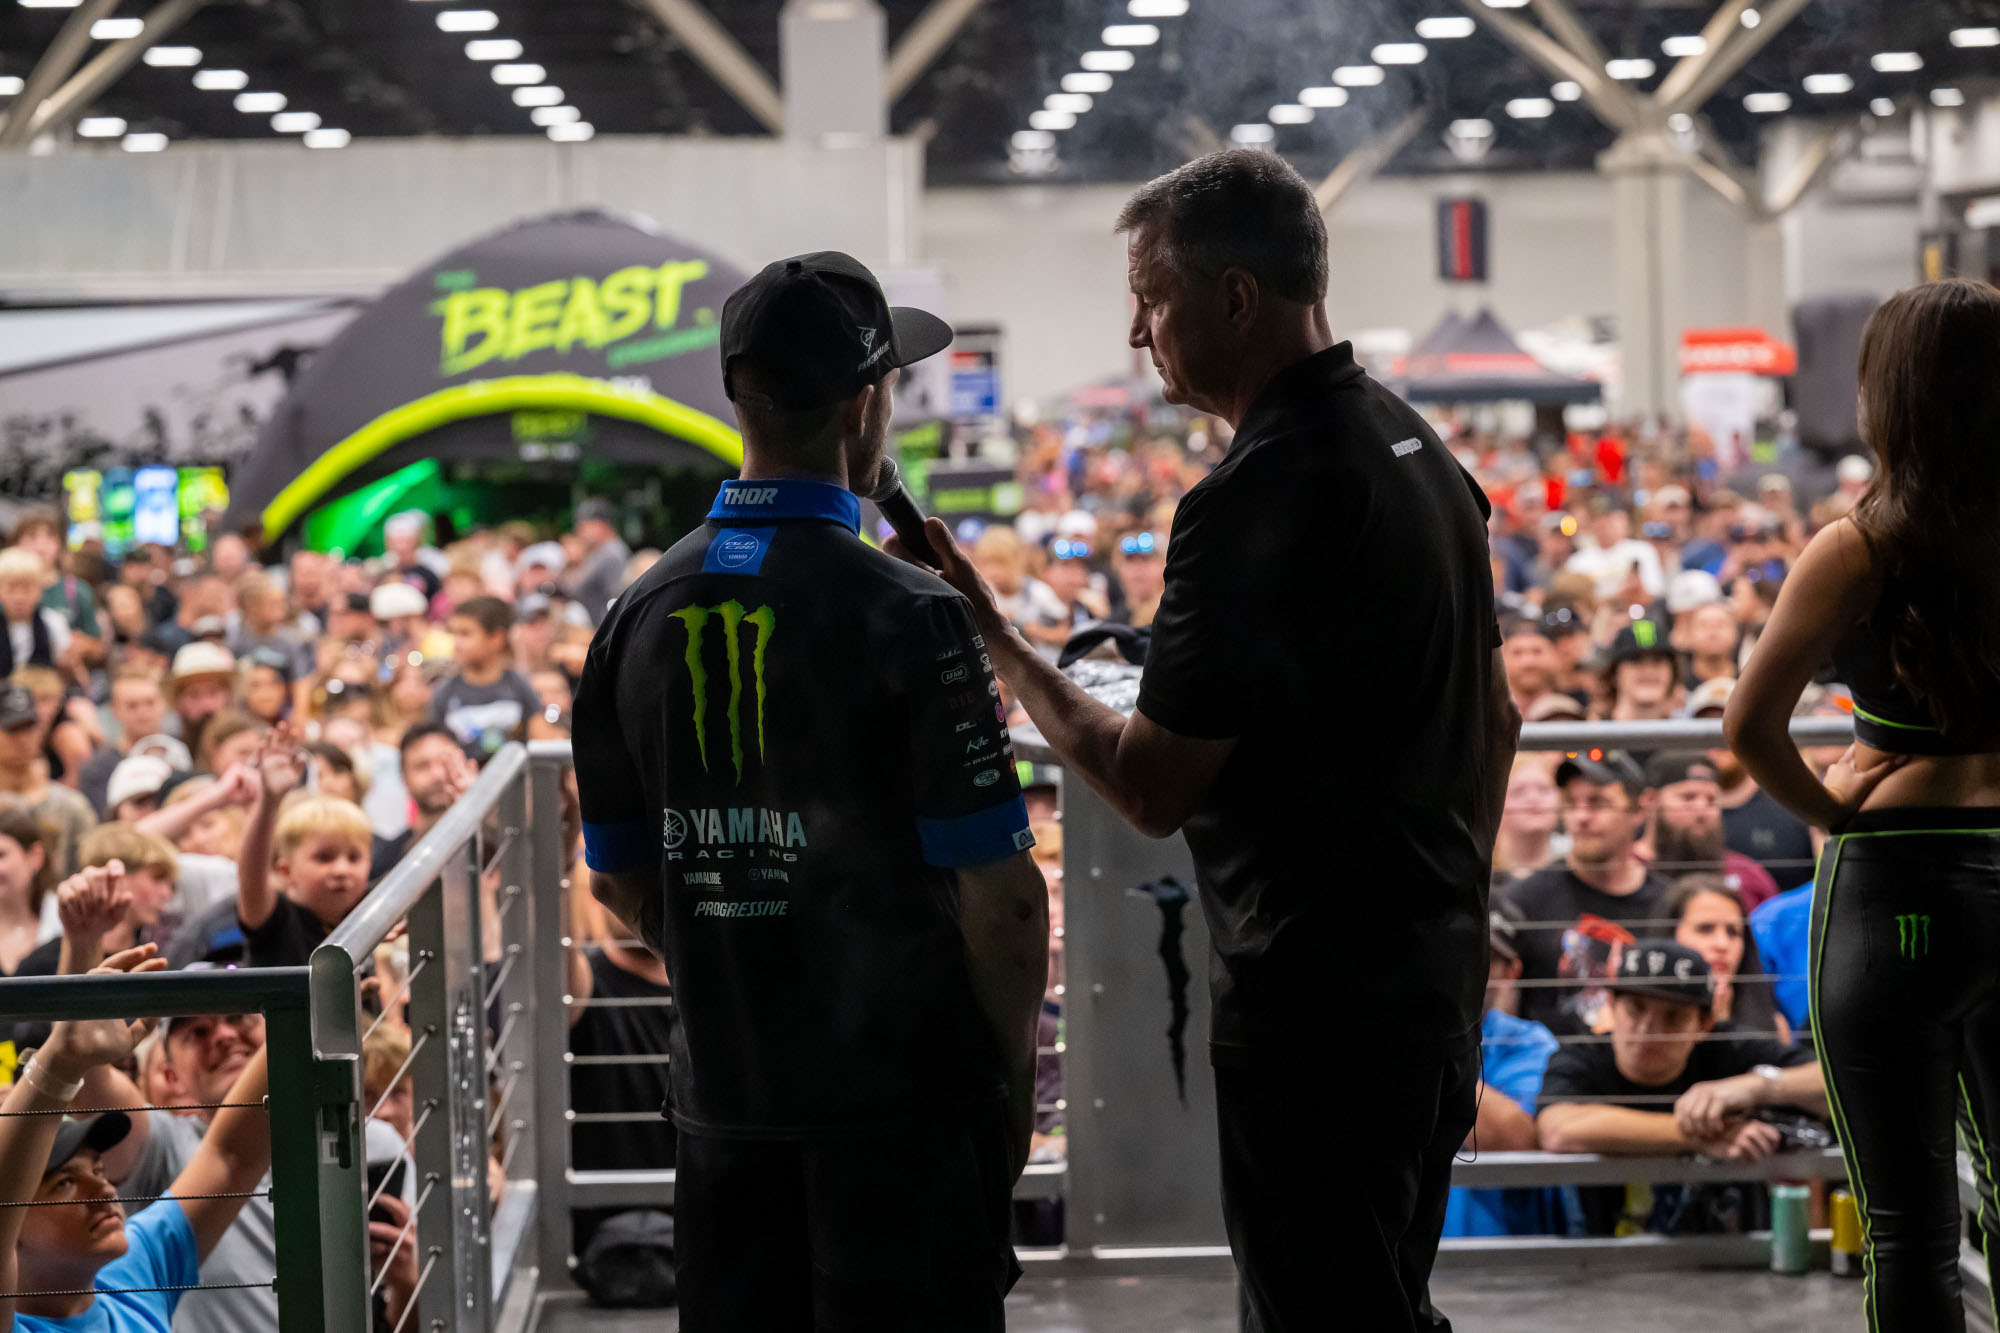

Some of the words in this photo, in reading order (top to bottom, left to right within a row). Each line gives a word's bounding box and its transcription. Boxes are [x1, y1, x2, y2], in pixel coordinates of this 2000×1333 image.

[430, 259, 709, 377] BEAST
[724, 487, 779, 505] THOR
[946, 669, 964, 681] AFAM
[689, 807, 808, 848] YAMAHA
[667, 849, 798, 862] RACING
[683, 871, 722, 885] YAMALUBE
[694, 900, 789, 917] PROGRESSIVE
